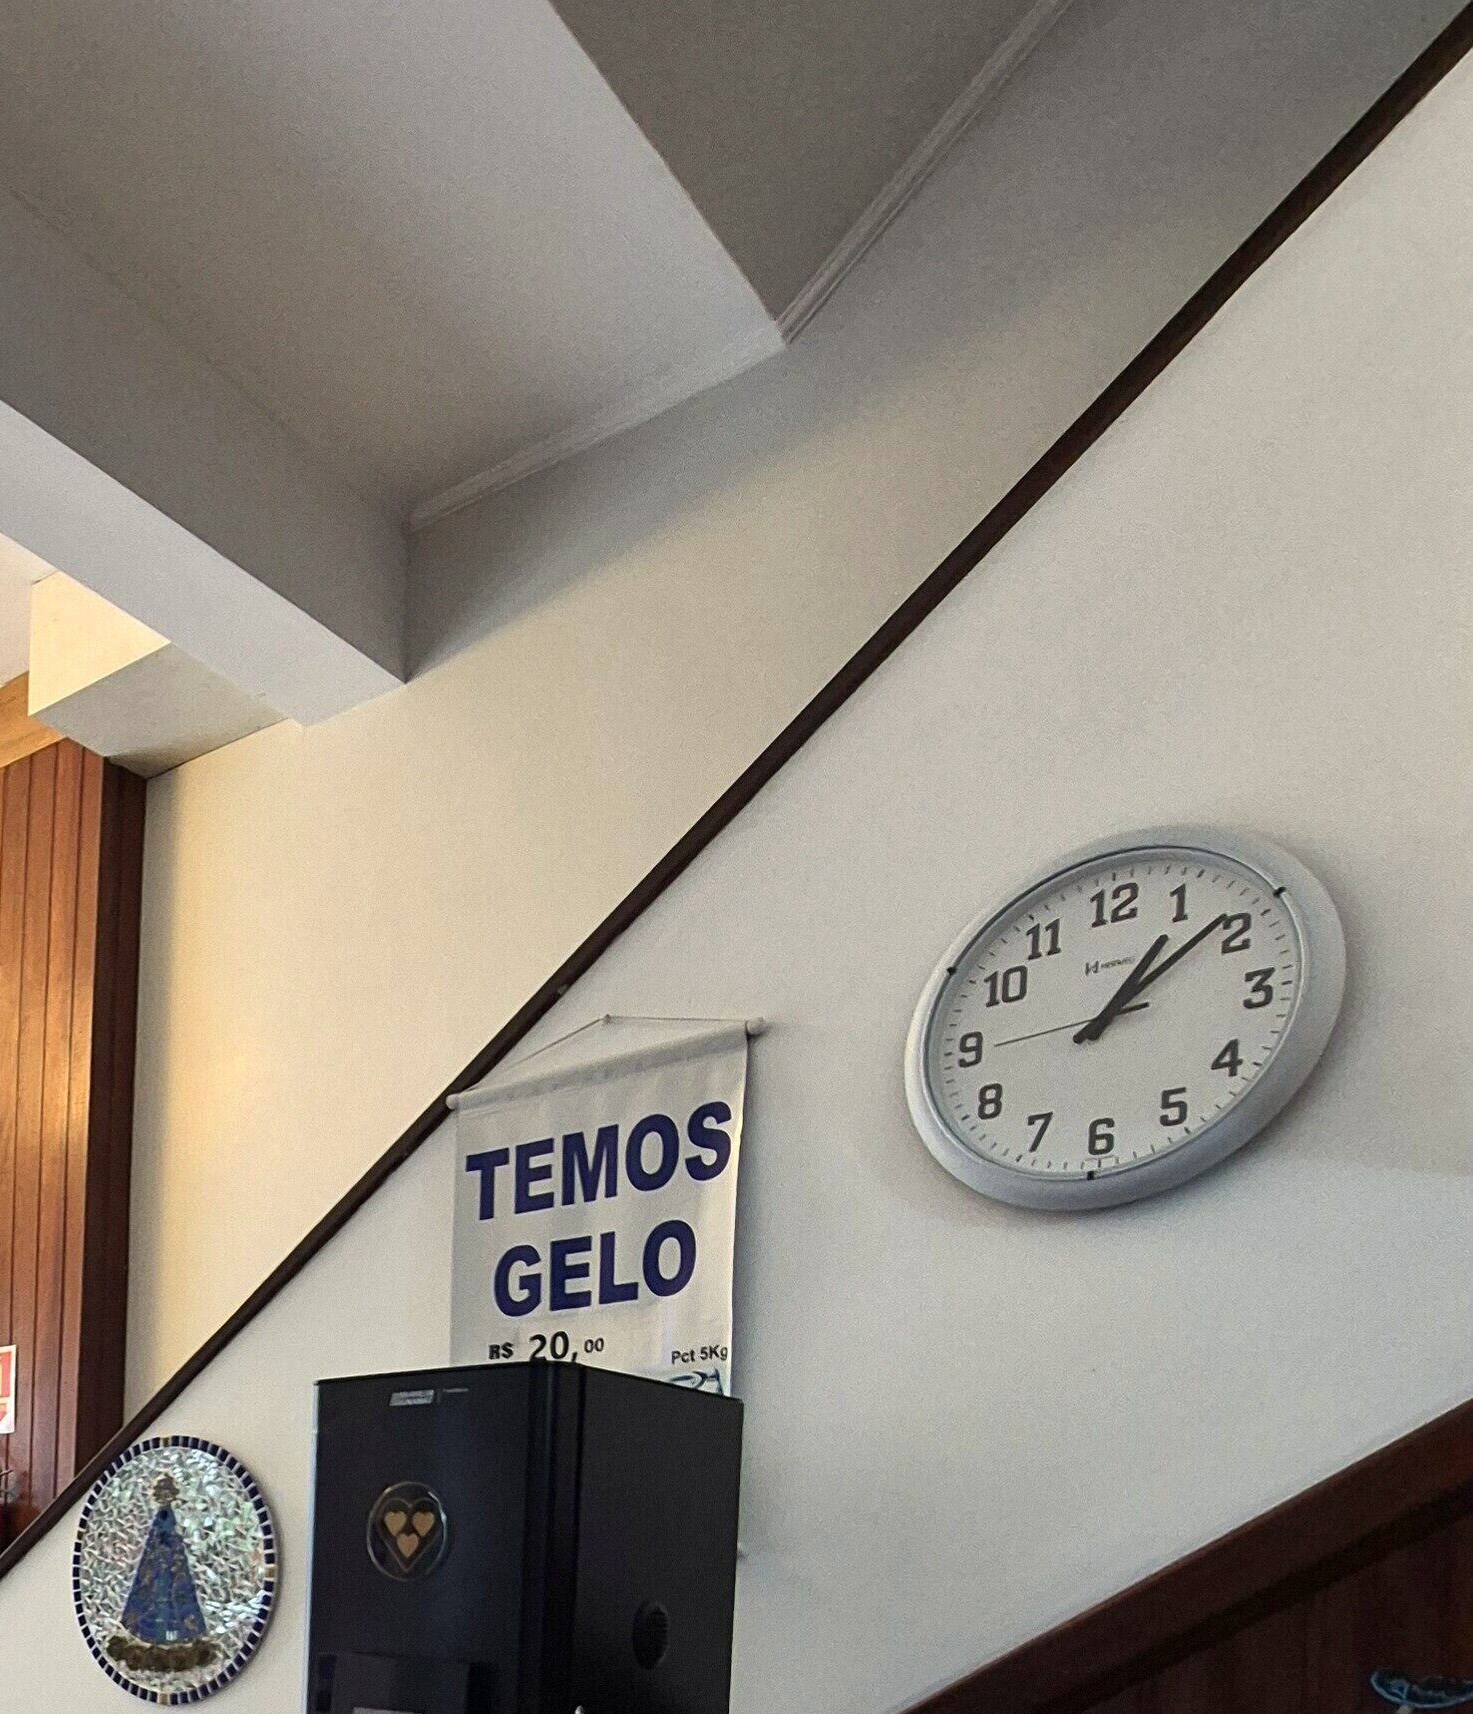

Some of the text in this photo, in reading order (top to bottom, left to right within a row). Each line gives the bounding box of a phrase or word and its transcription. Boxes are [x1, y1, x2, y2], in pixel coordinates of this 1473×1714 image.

[1089, 882, 1140, 928] 12
[1169, 883, 1189, 924] 1
[1025, 917, 1062, 961] 11
[1221, 912, 1252, 955] 2
[983, 965, 1028, 1008] 10
[1242, 966, 1277, 1010] 3
[957, 1031, 984, 1069] 9
[1210, 1038, 1244, 1078] 4
[977, 1082, 1004, 1121] 8
[1159, 1086, 1189, 1127] 5
[1027, 1111, 1054, 1153] 7
[1087, 1117, 1116, 1156] 6
[464, 1101, 733, 1221] TEMOS
[493, 1219, 697, 1318] GELO
[671, 1344, 729, 1365] Pct 5Kg
